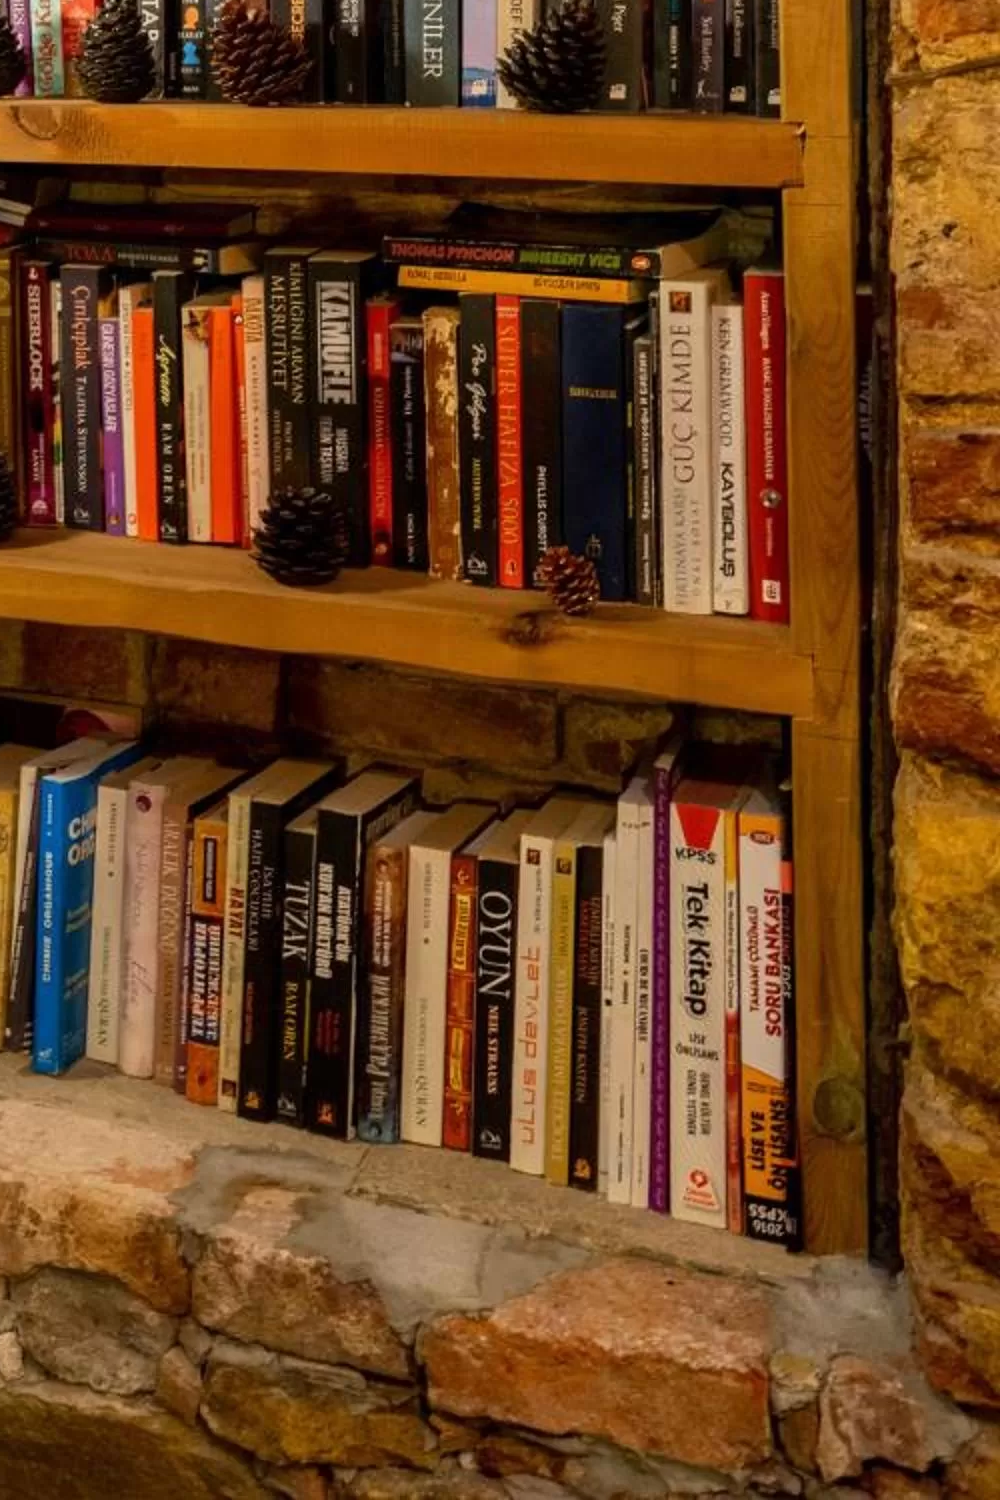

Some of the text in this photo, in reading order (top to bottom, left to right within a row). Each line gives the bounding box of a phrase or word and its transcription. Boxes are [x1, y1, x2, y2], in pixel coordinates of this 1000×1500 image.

[391, 242, 622, 269] THOMAS PYNCHON INHERENT VICE
[27, 283, 44, 392] SHERLOCK
[268, 275, 289, 391] MEŞRUTİYET
[290, 262, 306, 405] KİMLİĞİNİ ARAYAN
[321, 280, 353, 405] KAMUFLE
[668, 323, 693, 414] KİMDE
[77, 428, 88, 493] STEVENSON
[161, 422, 174, 504] RAM OREN
[498, 325, 519, 544] SÜPER HAFIZA 5000
[669, 422, 697, 484] GÜÇ
[718, 317, 736, 578] KEN GRIMWOOD KAYBOLUŞ
[536, 465, 548, 510] PHYLLIS
[161, 819, 178, 877] ARALIK
[675, 846, 719, 865] KPSS
[229, 887, 244, 940] HAYAT
[282, 880, 310, 961] TUZAK
[314, 916, 333, 979] KÜLTÜRÜ
[335, 885, 351, 963] ATATÜRK'ÜN
[683, 881, 711, 1017] Tek Kitap
[478, 890, 512, 1095] OYUN NEIL STRAUSS
[747, 905, 759, 1013] TAMAMI ÇÖZÜMLÜ
[766, 888, 783, 1038] SORU BANKASI
[283, 981, 299, 1061] RAM OREN
[750, 1111, 765, 1171] LİSE VE
[769, 1094, 786, 1191] ÖN LİSANS
